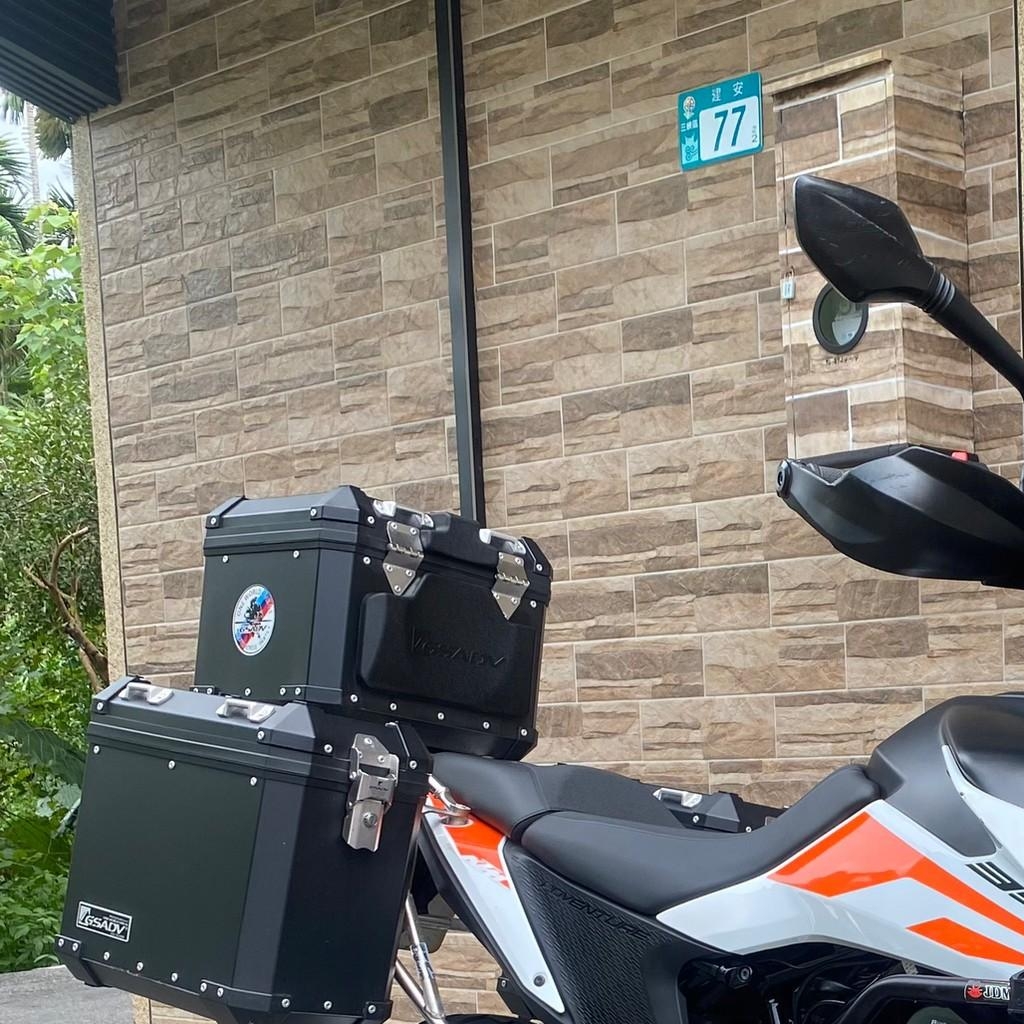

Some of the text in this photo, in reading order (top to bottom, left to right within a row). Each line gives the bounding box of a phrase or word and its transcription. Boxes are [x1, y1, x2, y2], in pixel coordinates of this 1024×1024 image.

[712, 81, 744, 102] 建安
[714, 104, 746, 152] 77
[84, 914, 126, 935] GSADV
